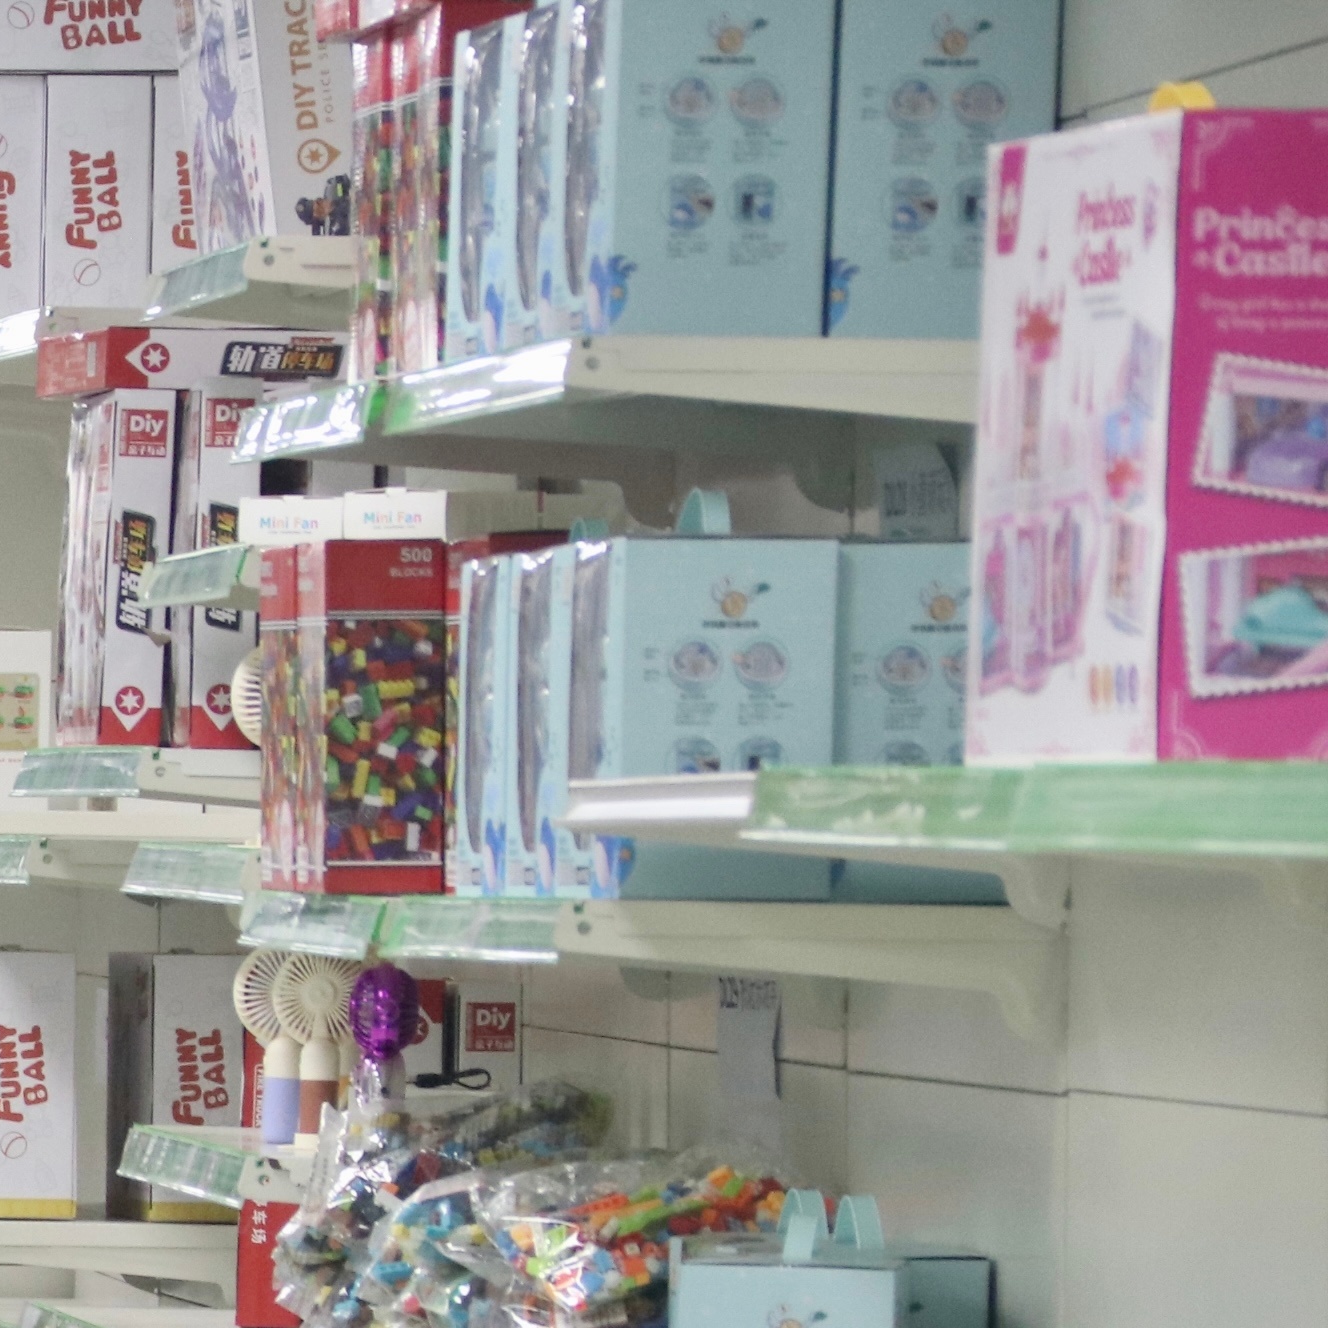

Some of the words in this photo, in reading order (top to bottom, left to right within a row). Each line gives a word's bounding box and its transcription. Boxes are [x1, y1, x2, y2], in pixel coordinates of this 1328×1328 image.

[44, 0, 142, 26] FUNNY
[61, 19, 141, 50] BALL
[295, 86, 319, 131] DIY
[320, 69, 335, 124] POLICE
[65, 150, 98, 249] FUNNY
[93, 151, 123, 232] BALL
[130, 414, 164, 437] Diy
[260, 517, 289, 529] Mini
[293, 517, 319, 530] Fan
[363, 512, 392, 524] Mini
[397, 511, 422, 523] Fan
[400, 548, 433, 563] 500
[476, 1009, 511, 1029] Diy
[18, 1025, 48, 1106] BALL
[173, 1028, 204, 1125] FUNNY
[199, 1029, 229, 1110] BALL
